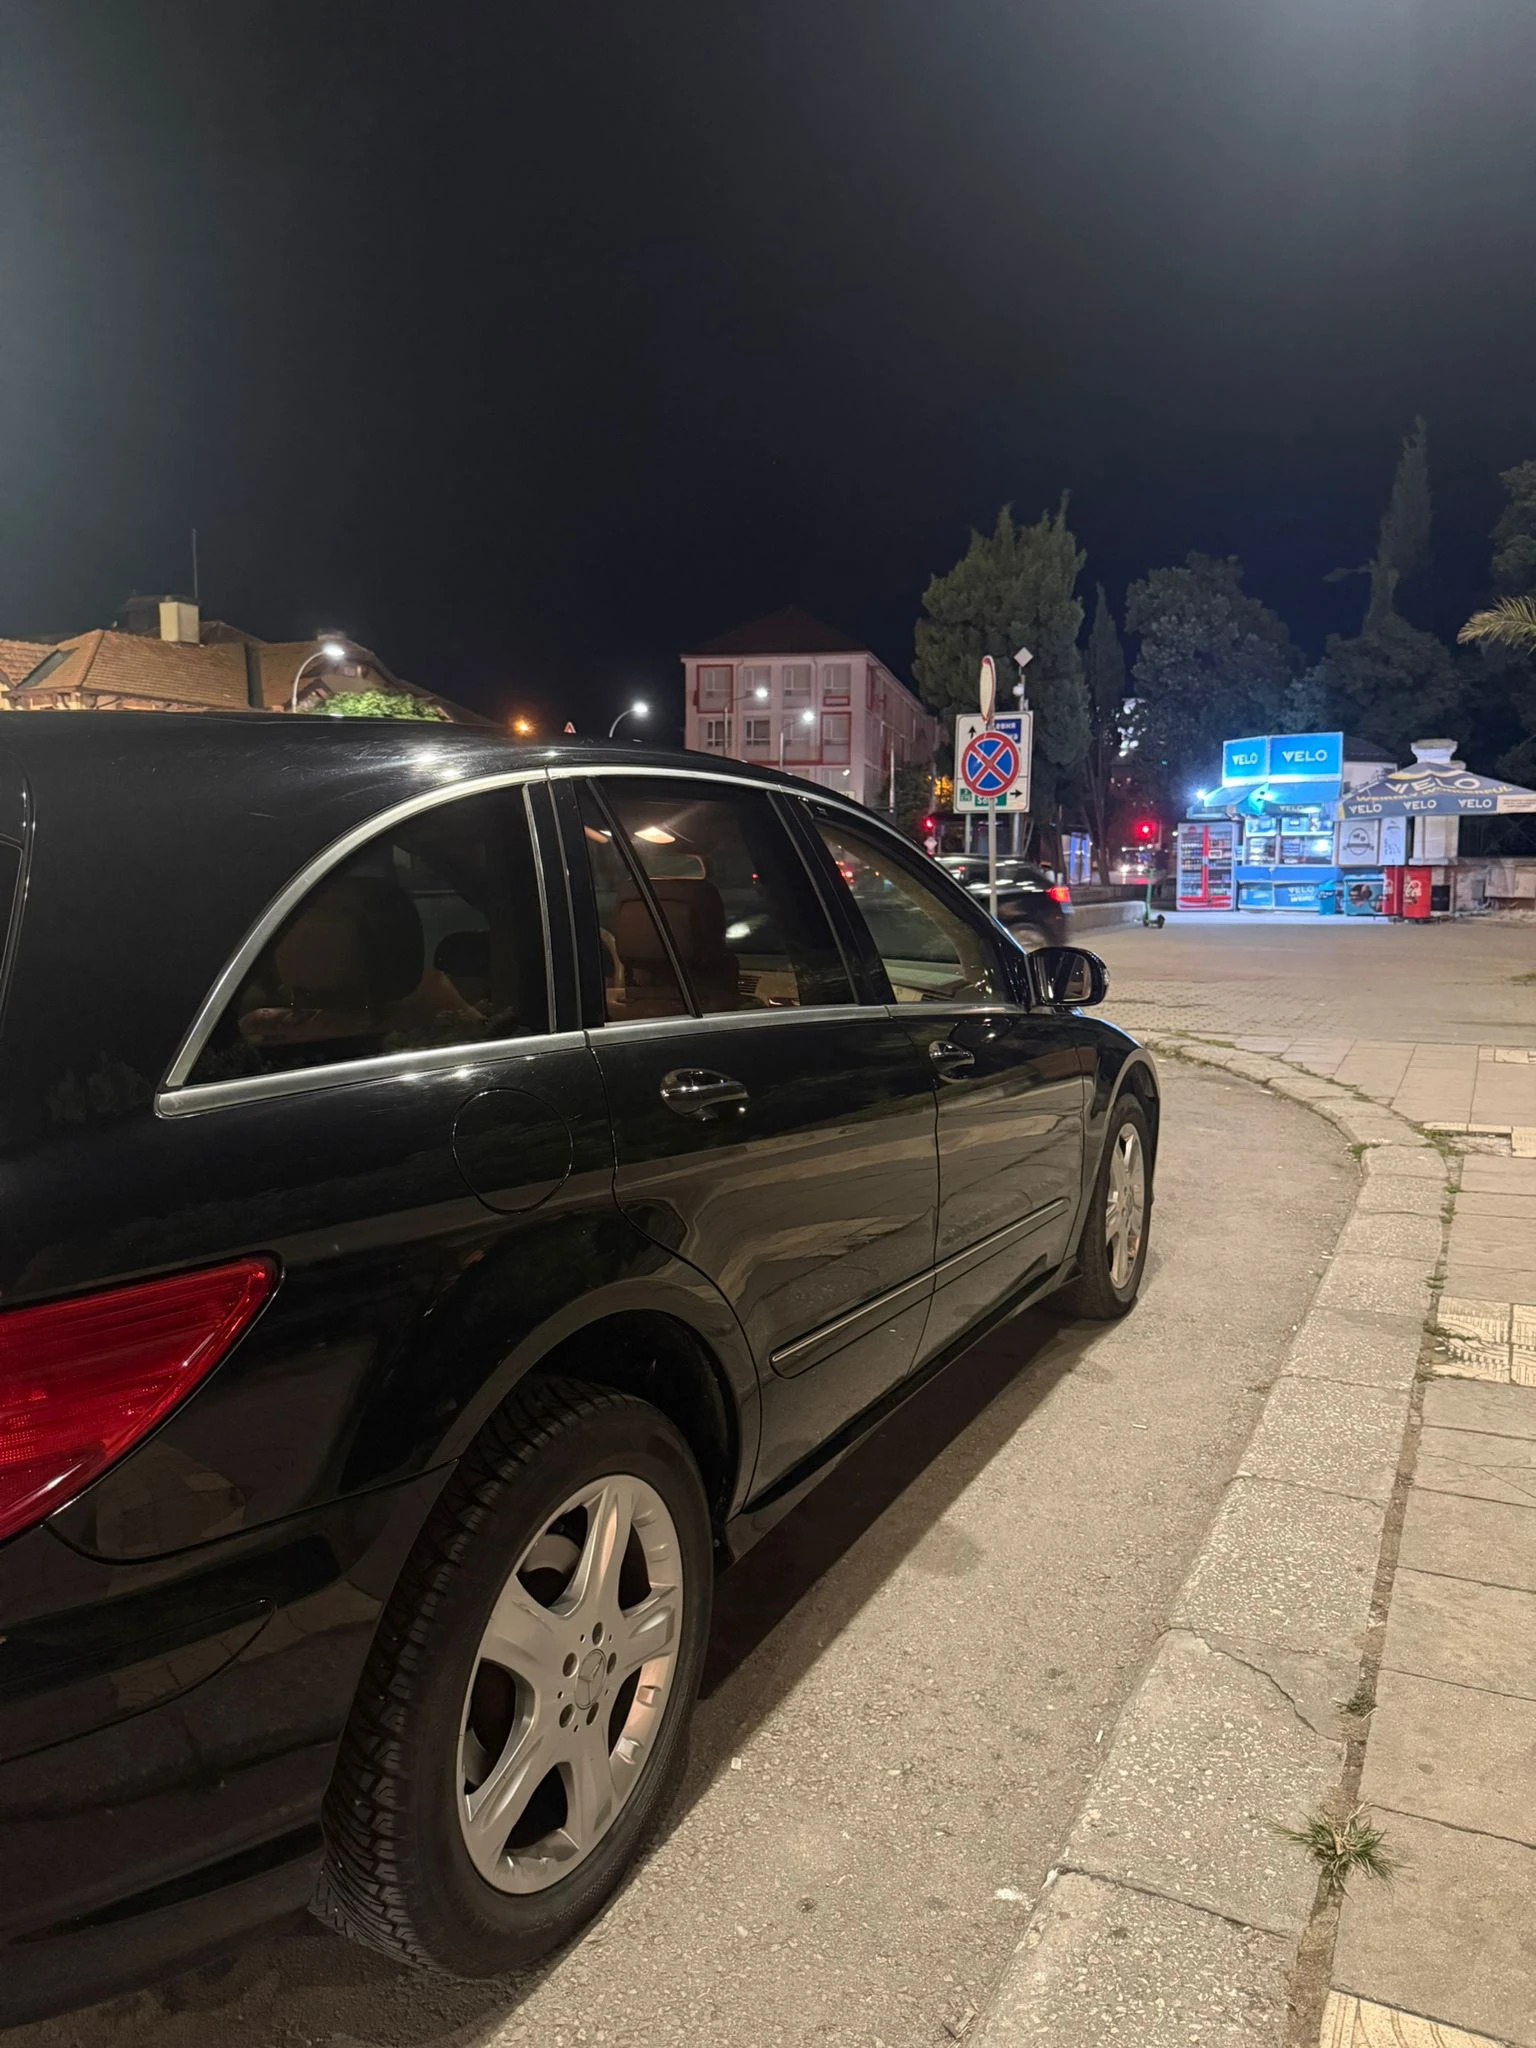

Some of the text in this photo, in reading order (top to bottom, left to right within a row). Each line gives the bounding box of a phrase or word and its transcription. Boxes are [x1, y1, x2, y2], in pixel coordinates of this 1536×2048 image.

[1232, 752, 1258, 765] VELO
[1282, 749, 1327, 762] VELO
[1385, 777, 1481, 794] VELO
[1349, 804, 1382, 814] VELO
[1403, 799, 1437, 810] VELO
[1458, 799, 1492, 809] VELO
[1288, 885, 1315, 895] VELO
